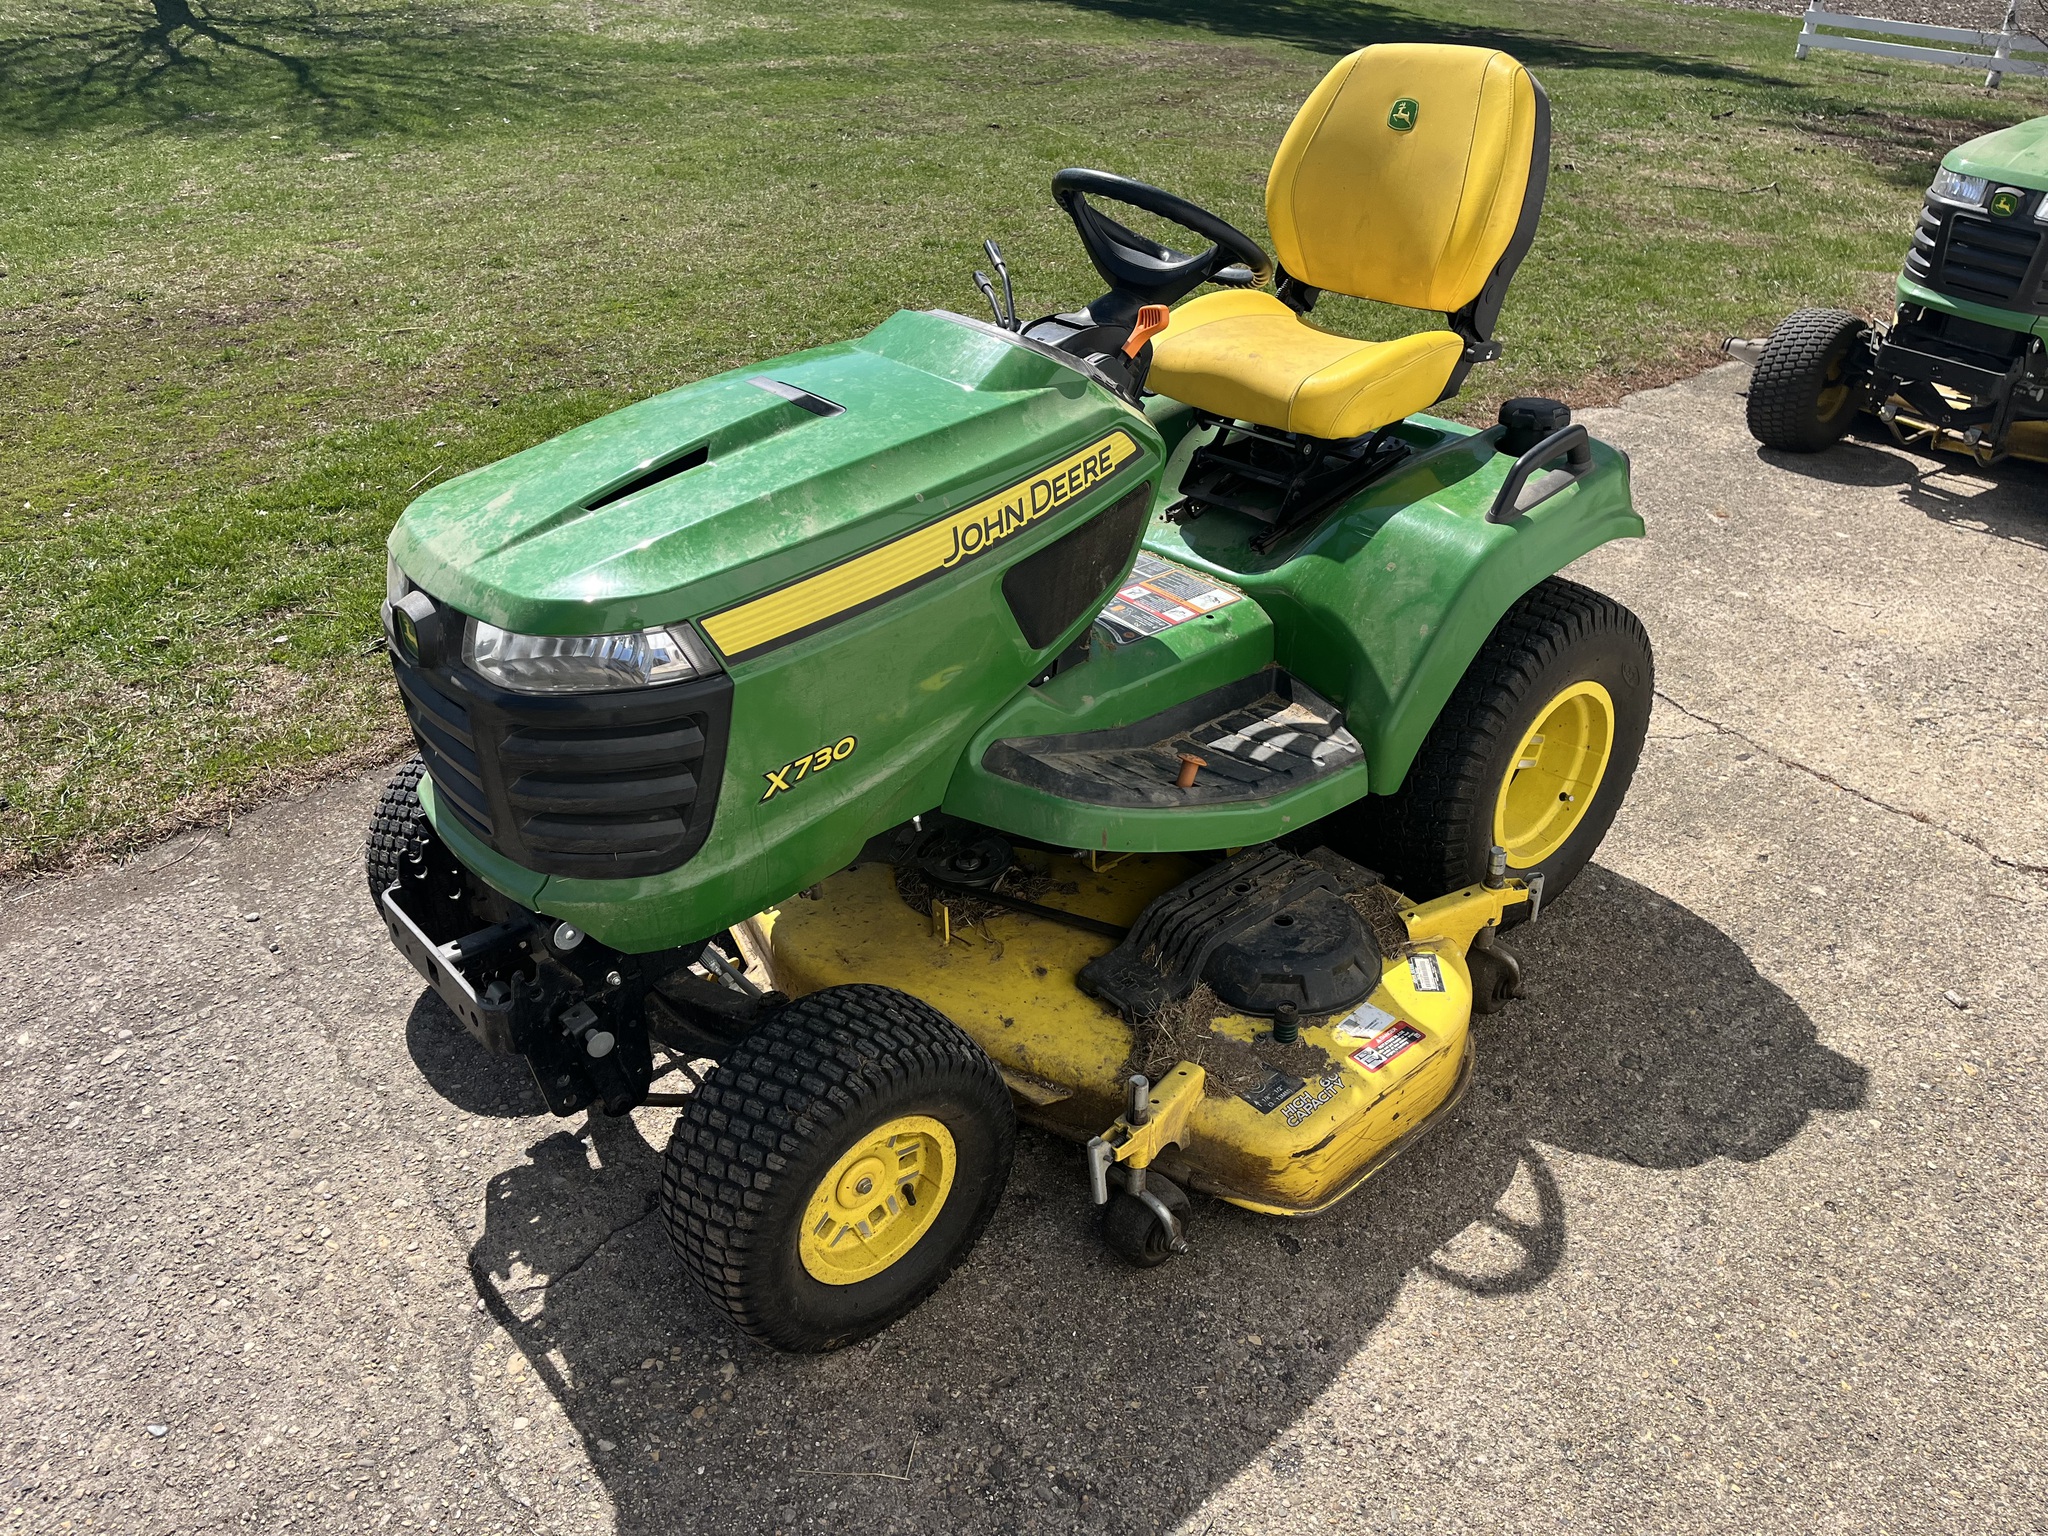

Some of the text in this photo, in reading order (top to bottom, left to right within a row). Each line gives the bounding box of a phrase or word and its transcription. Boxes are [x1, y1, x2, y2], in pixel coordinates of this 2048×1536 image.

[943, 444, 1114, 566] JOHN DEERE
[759, 735, 858, 803] X730
[1280, 1090, 1313, 1118] HIGH
[1286, 1077, 1346, 1127] CAPACITY
